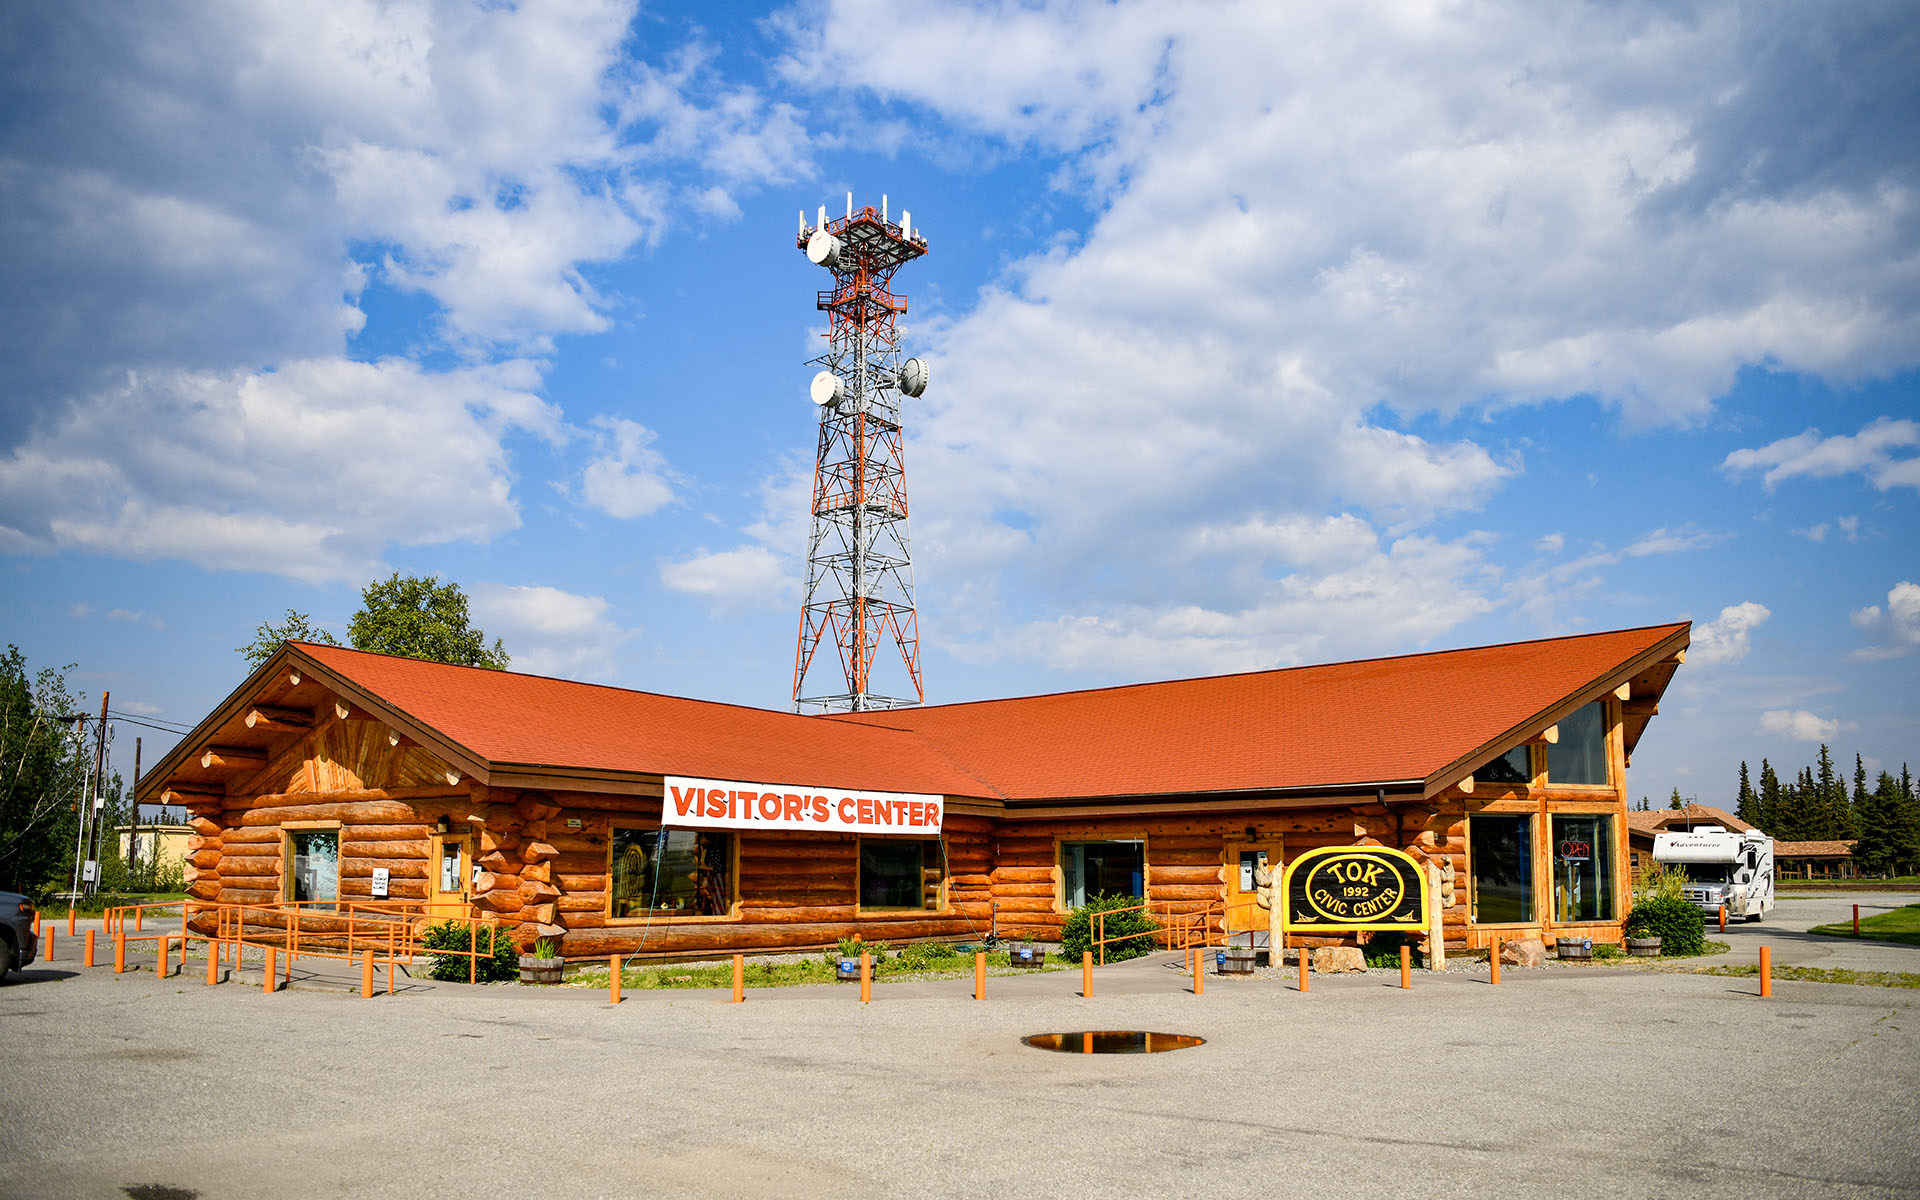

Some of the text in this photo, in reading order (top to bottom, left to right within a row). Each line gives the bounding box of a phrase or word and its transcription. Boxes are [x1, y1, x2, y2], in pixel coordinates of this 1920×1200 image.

[670, 786, 940, 826] VISITOR'S CENTER
[1561, 841, 1590, 857] OPEN
[1327, 862, 1384, 886] TOK
[1315, 888, 1398, 915] CIVIC CENTER
[1343, 887, 1369, 897] 1992
